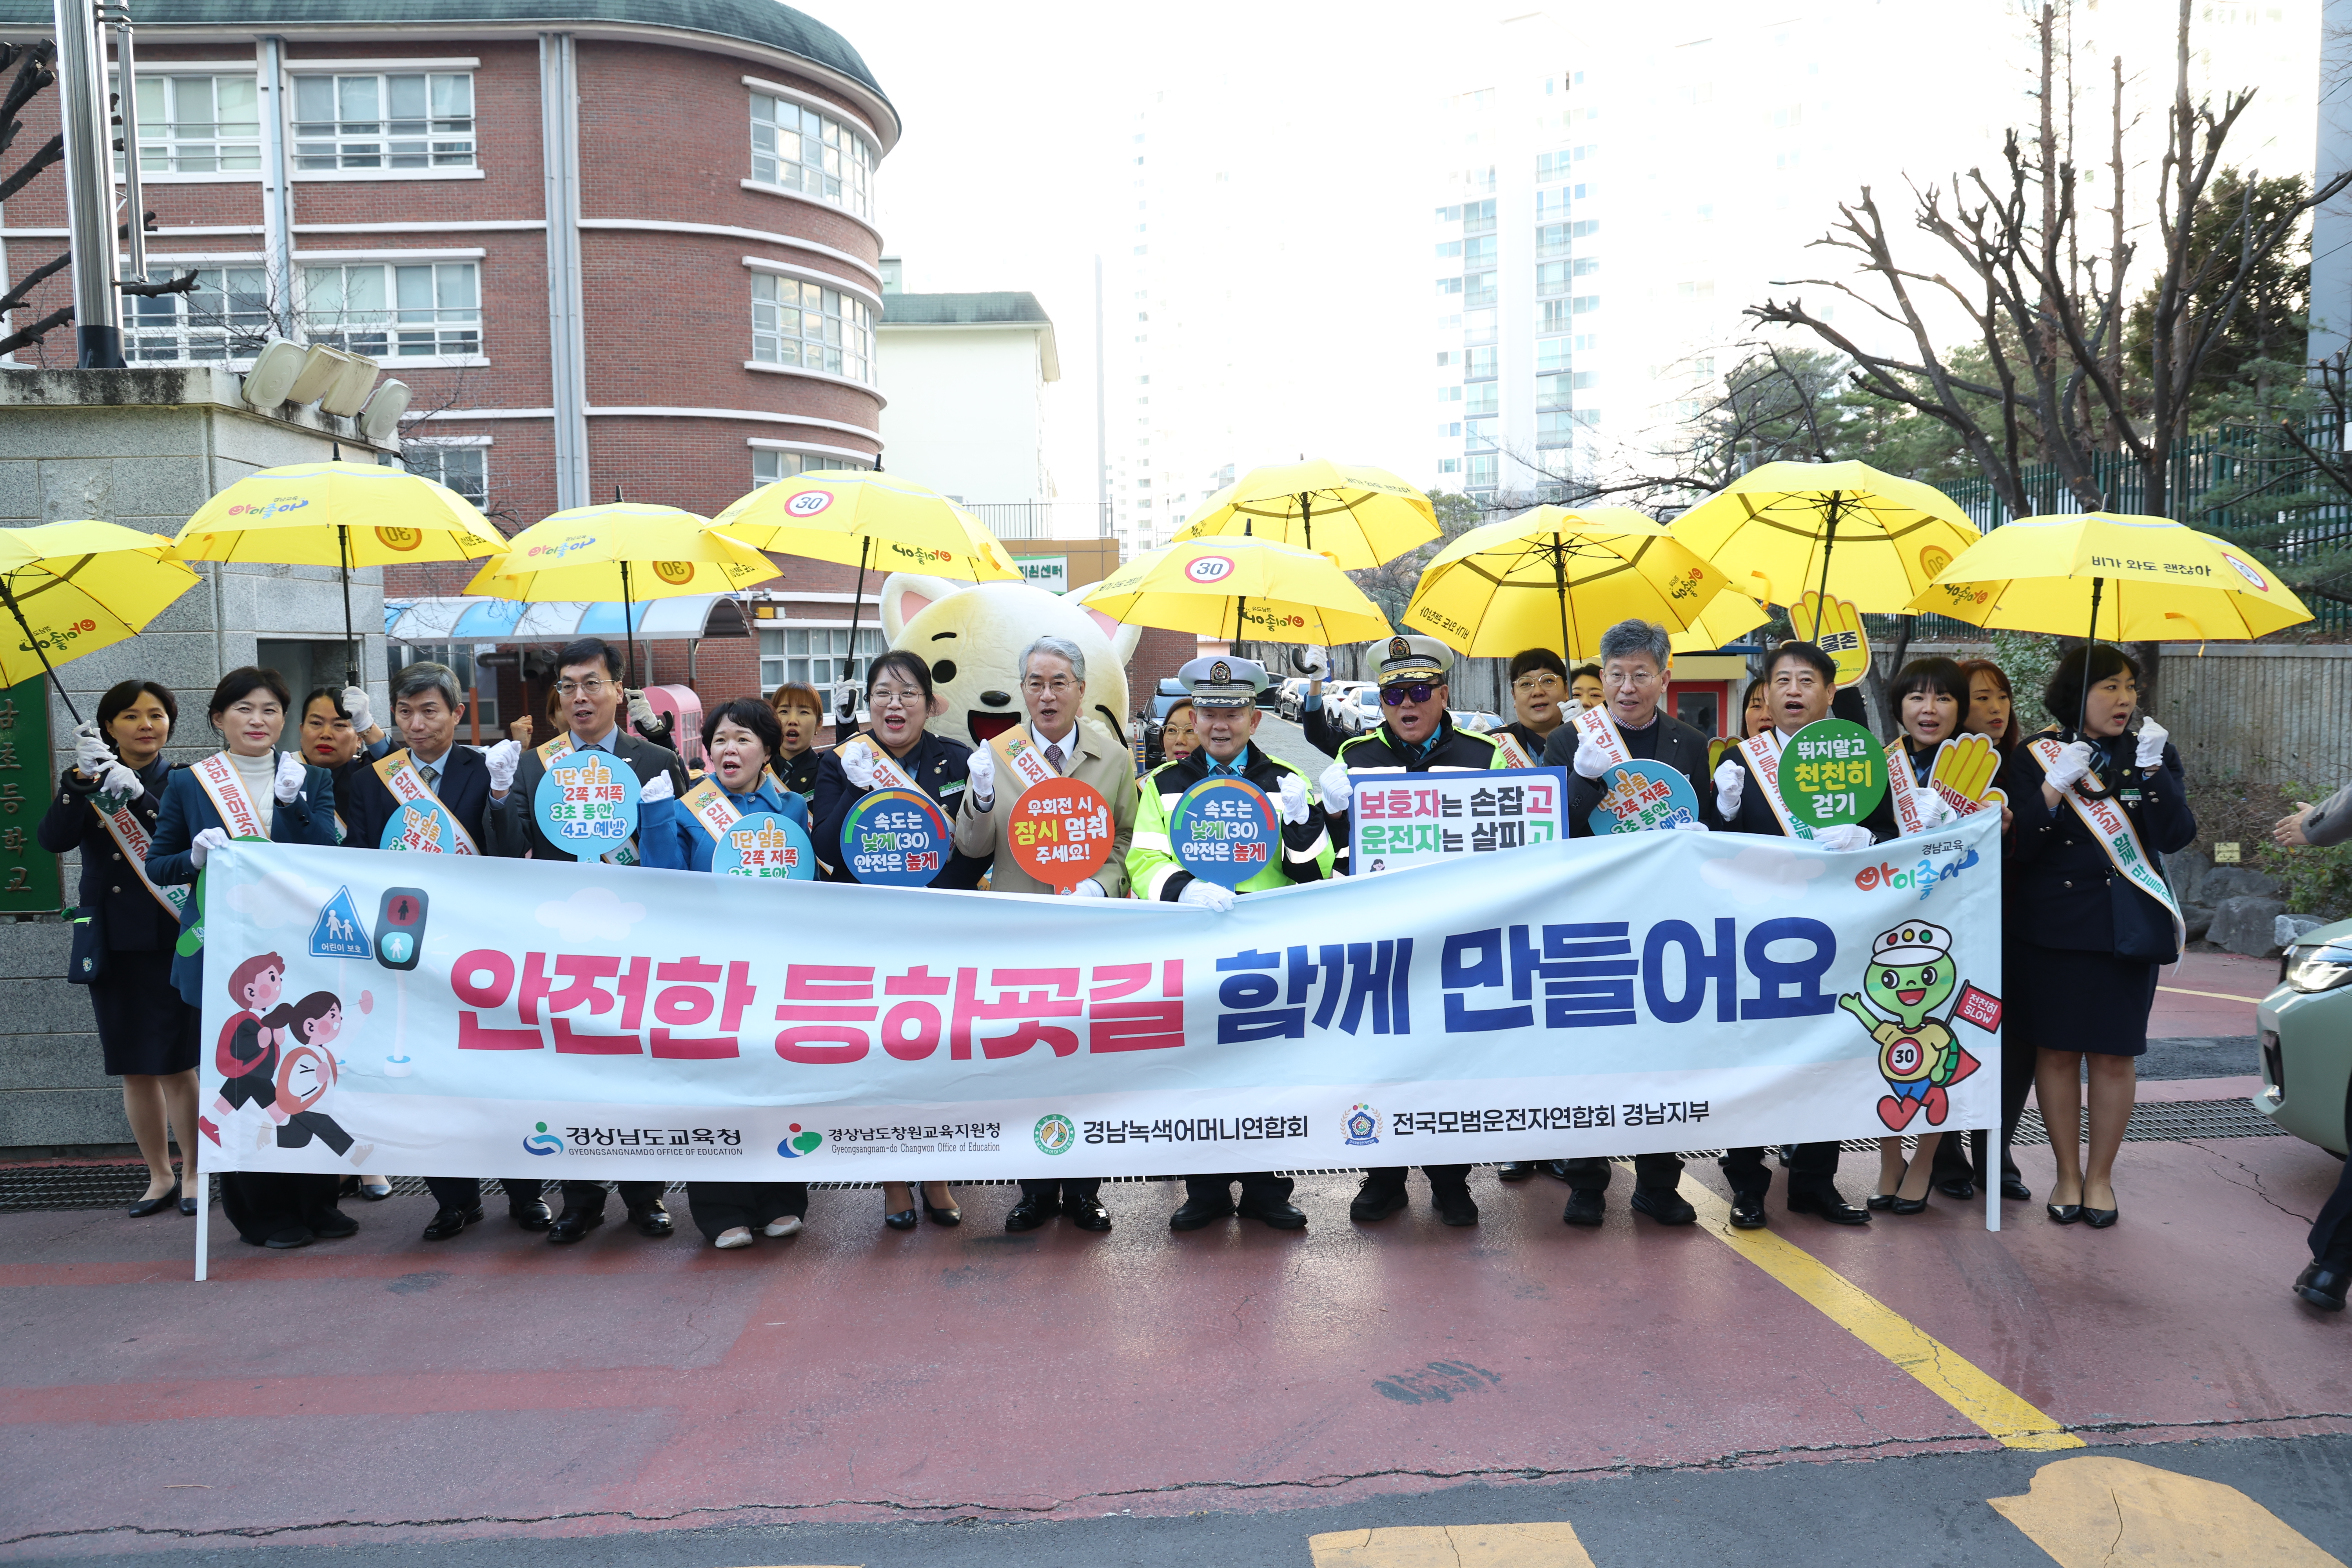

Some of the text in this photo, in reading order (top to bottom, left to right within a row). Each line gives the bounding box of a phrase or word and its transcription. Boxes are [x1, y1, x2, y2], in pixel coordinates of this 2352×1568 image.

[796, 497, 823, 509] 30
[1196, 562, 1223, 575] 30
[2092, 555, 2211, 577] 비가 와도 괜찮아
[1797, 739, 1867, 760] 뛰지말고
[554, 768, 610, 785] 1단 멈춤
[1617, 774, 1648, 798] 멈춤
[1795, 760, 1872, 792] 천천히
[1888, 755, 1909, 796] 안전한
[565, 785, 623, 802] 2쪽 저쪽
[1361, 785, 1552, 819] 보호자는 손잡고
[1613, 781, 1670, 819] 2쪽 저쪽
[552, 803, 612, 820] 3초 동안
[1027, 796, 1093, 817] 우회전 시
[1204, 800, 1253, 819] 속도는
[1639, 801, 1671, 825] 동안
[1812, 792, 1855, 819] 걷기
[404, 808, 441, 842] 1단 멈춤
[563, 819, 625, 836] 4고 예방
[874, 811, 923, 830] 속도는
[1014, 815, 1108, 846] 잠시 멈춰
[1190, 820, 1259, 841] 낮게(30)
[403, 828, 421, 850] 2쪽
[731, 831, 785, 848] 1단 멈춤
[862, 831, 929, 854] 낮게(30)
[1361, 820, 1553, 855] 운전자는 살피고
[1922, 839, 1964, 855] 경남교육
[742, 848, 798, 866] 2쪽 저쪽
[1035, 843, 1091, 864] 주세요!
[1181, 841, 1267, 862] 안전은 높게
[2112, 833, 2138, 867] 함께
[853, 851, 939, 873] 안전은 높게
[1855, 848, 1980, 901] 아이좋아
[321, 942, 362, 953] 어린이 보호
[450, 917, 1837, 1064] 안전한 등하굣길 함께 만들어요
[1964, 1005, 1993, 1024] SLOW
[1969, 993, 1998, 1015] 천천히
[1895, 1049, 1914, 1063] 30
[1393, 1100, 1710, 1136] 전국모범운전자연합회 경남지부
[566, 1127, 741, 1146] 경상남도교육청
[828, 1122, 1000, 1142] 경상남도창원교육지원청
[1083, 1115, 1308, 1144] 경남녹색어머니연합회
[831, 1142, 1000, 1155] Gyeongsangnam-do Changwon Office of Education
